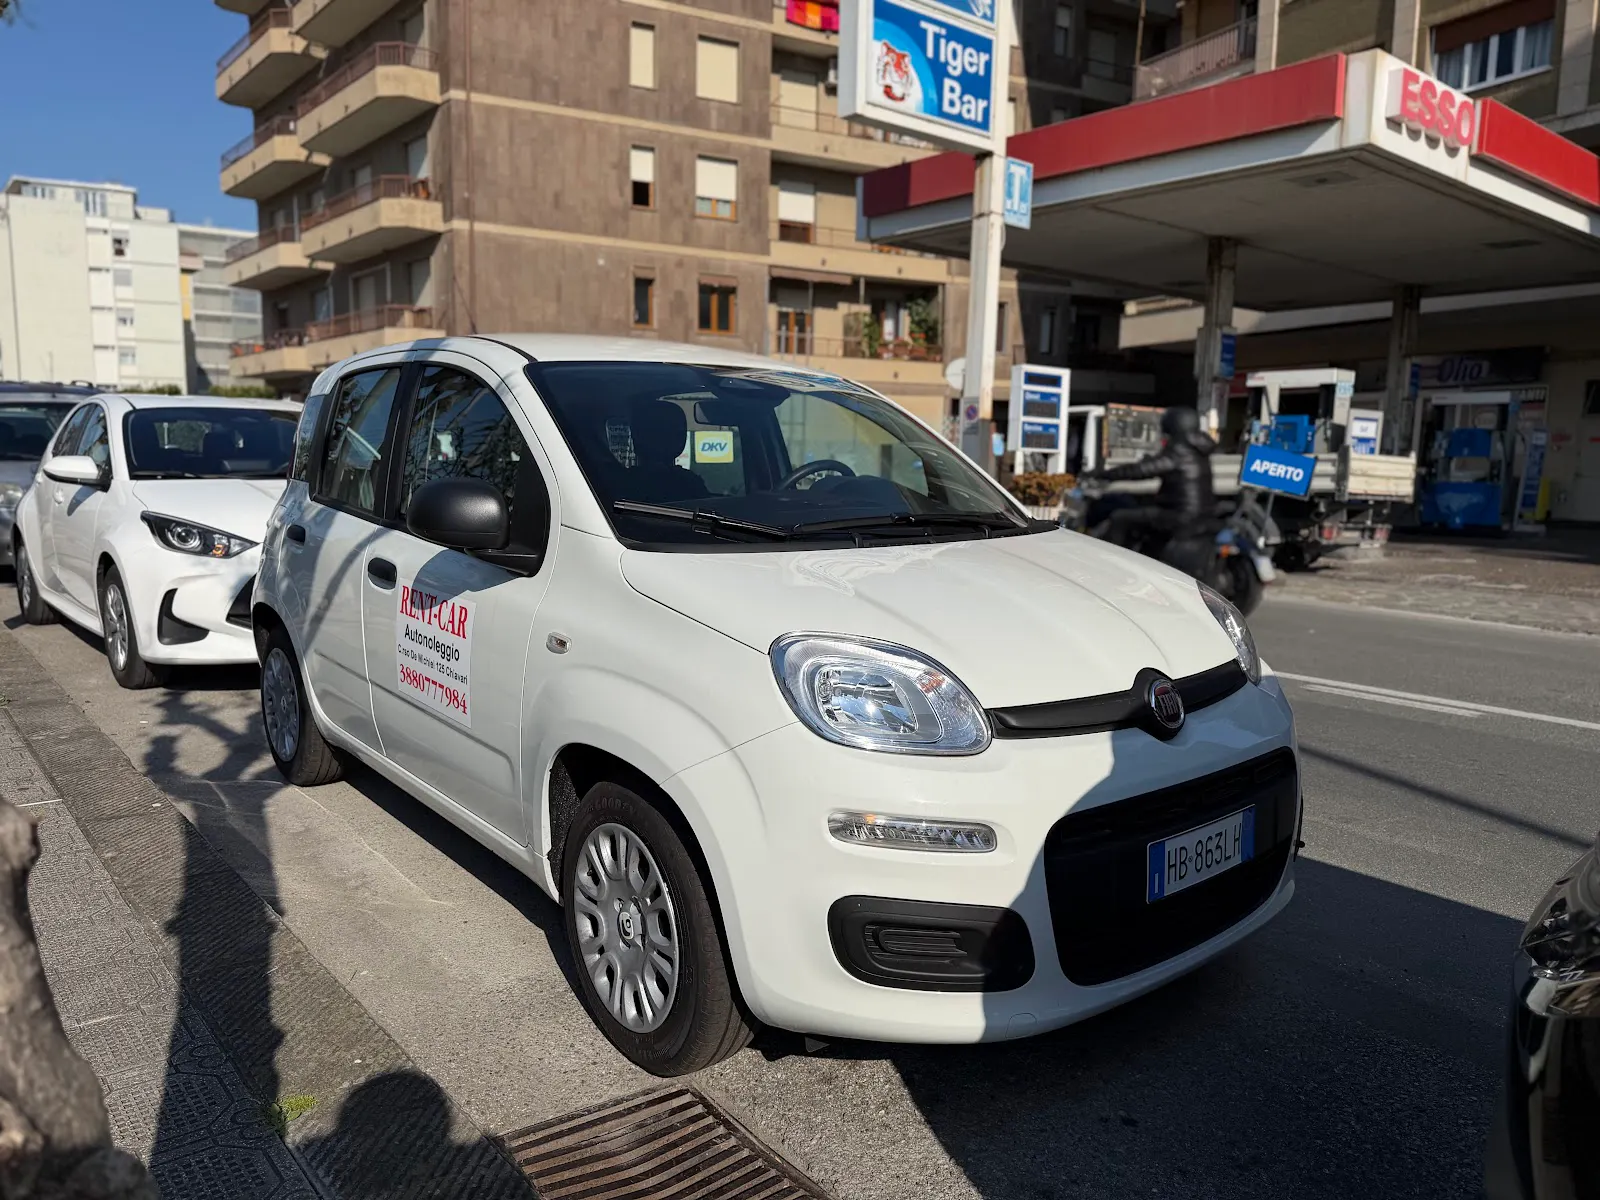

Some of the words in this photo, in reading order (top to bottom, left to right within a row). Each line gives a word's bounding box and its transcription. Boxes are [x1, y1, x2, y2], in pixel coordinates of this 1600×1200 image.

[919, 20, 990, 77] Tiger
[942, 77, 988, 123] Bar
[1400, 67, 1475, 146] ESSO
[700, 441, 728, 452] DKV
[1250, 458, 1305, 482] APERTO
[400, 585, 468, 640] RENT-CAR
[397, 643, 410, 658] Crso
[436, 661, 446, 675] 125
[446, 666, 468, 685] Chiavari
[404, 623, 460, 662] Autonoleggio
[399, 663, 468, 715] 3880777984
[1167, 846, 1188, 885] HB
[1194, 822, 1242, 873] 863LH
